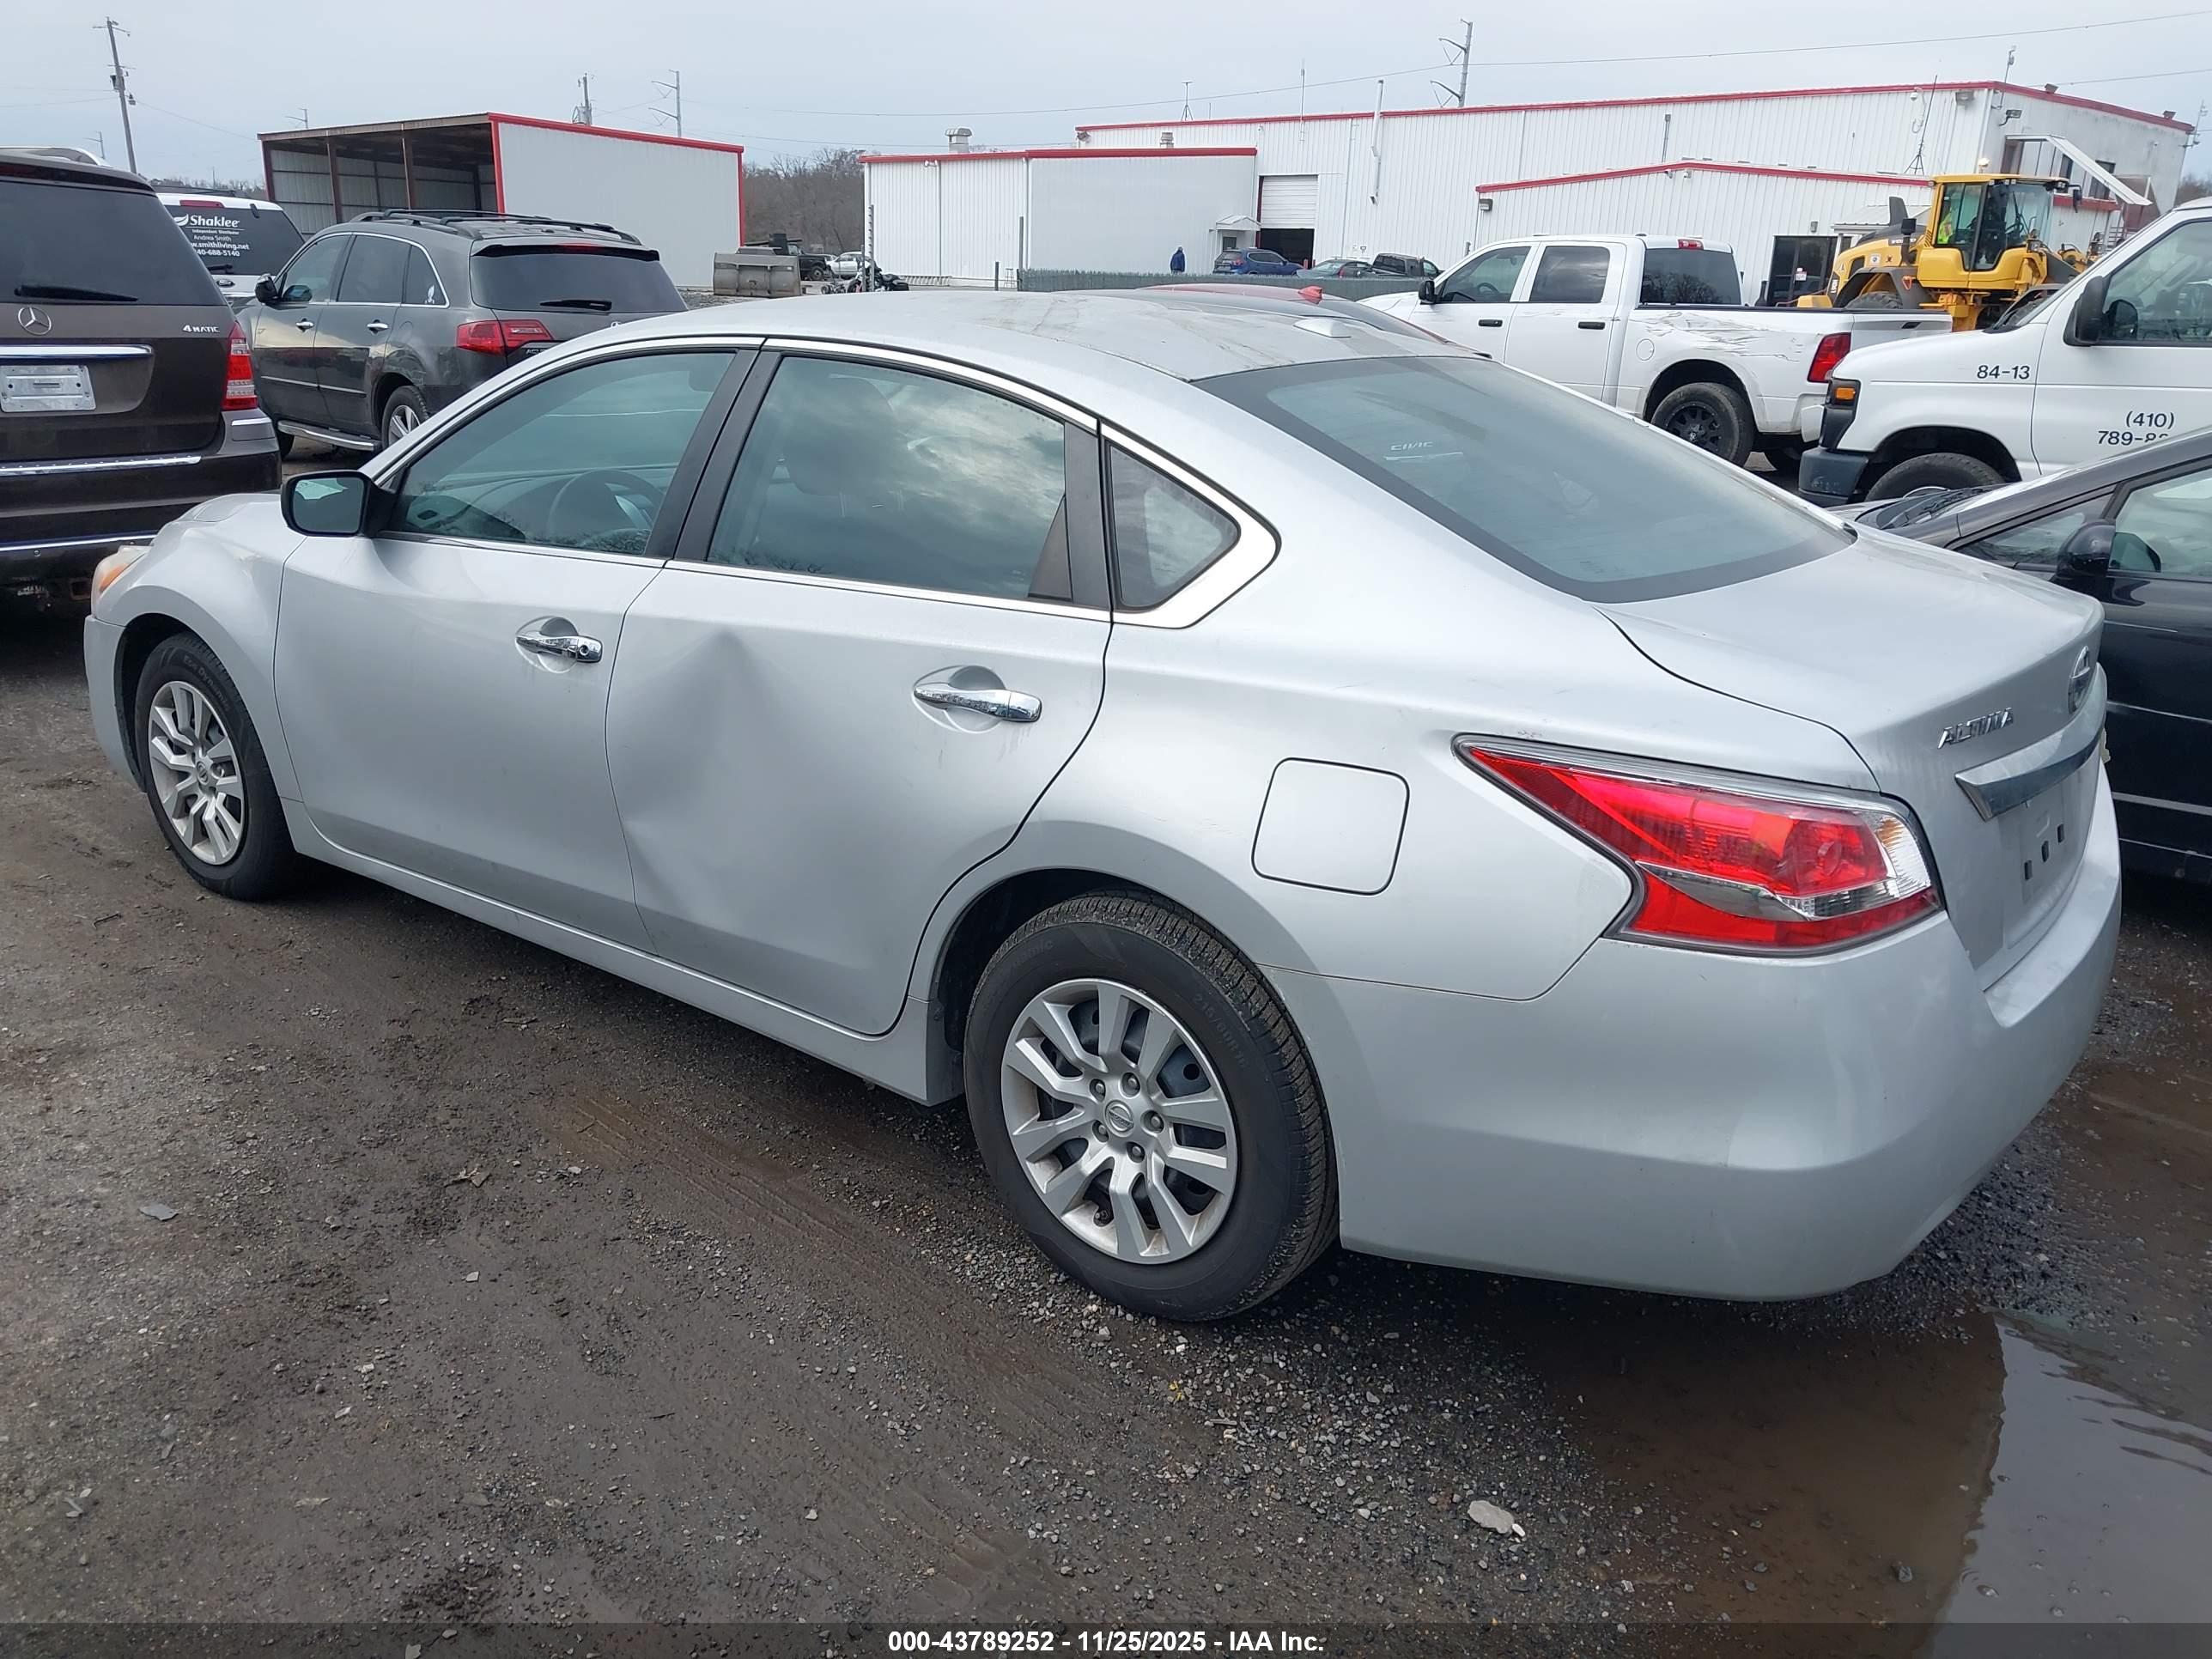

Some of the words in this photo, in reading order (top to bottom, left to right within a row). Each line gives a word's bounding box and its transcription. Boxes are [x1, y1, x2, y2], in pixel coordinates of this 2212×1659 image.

[190, 215, 239, 228] Shaklee
[1977, 365, 2030, 380] 84-13
[2125, 410, 2175, 429] (410)
[1937, 707, 2013, 750] ALTIMA
